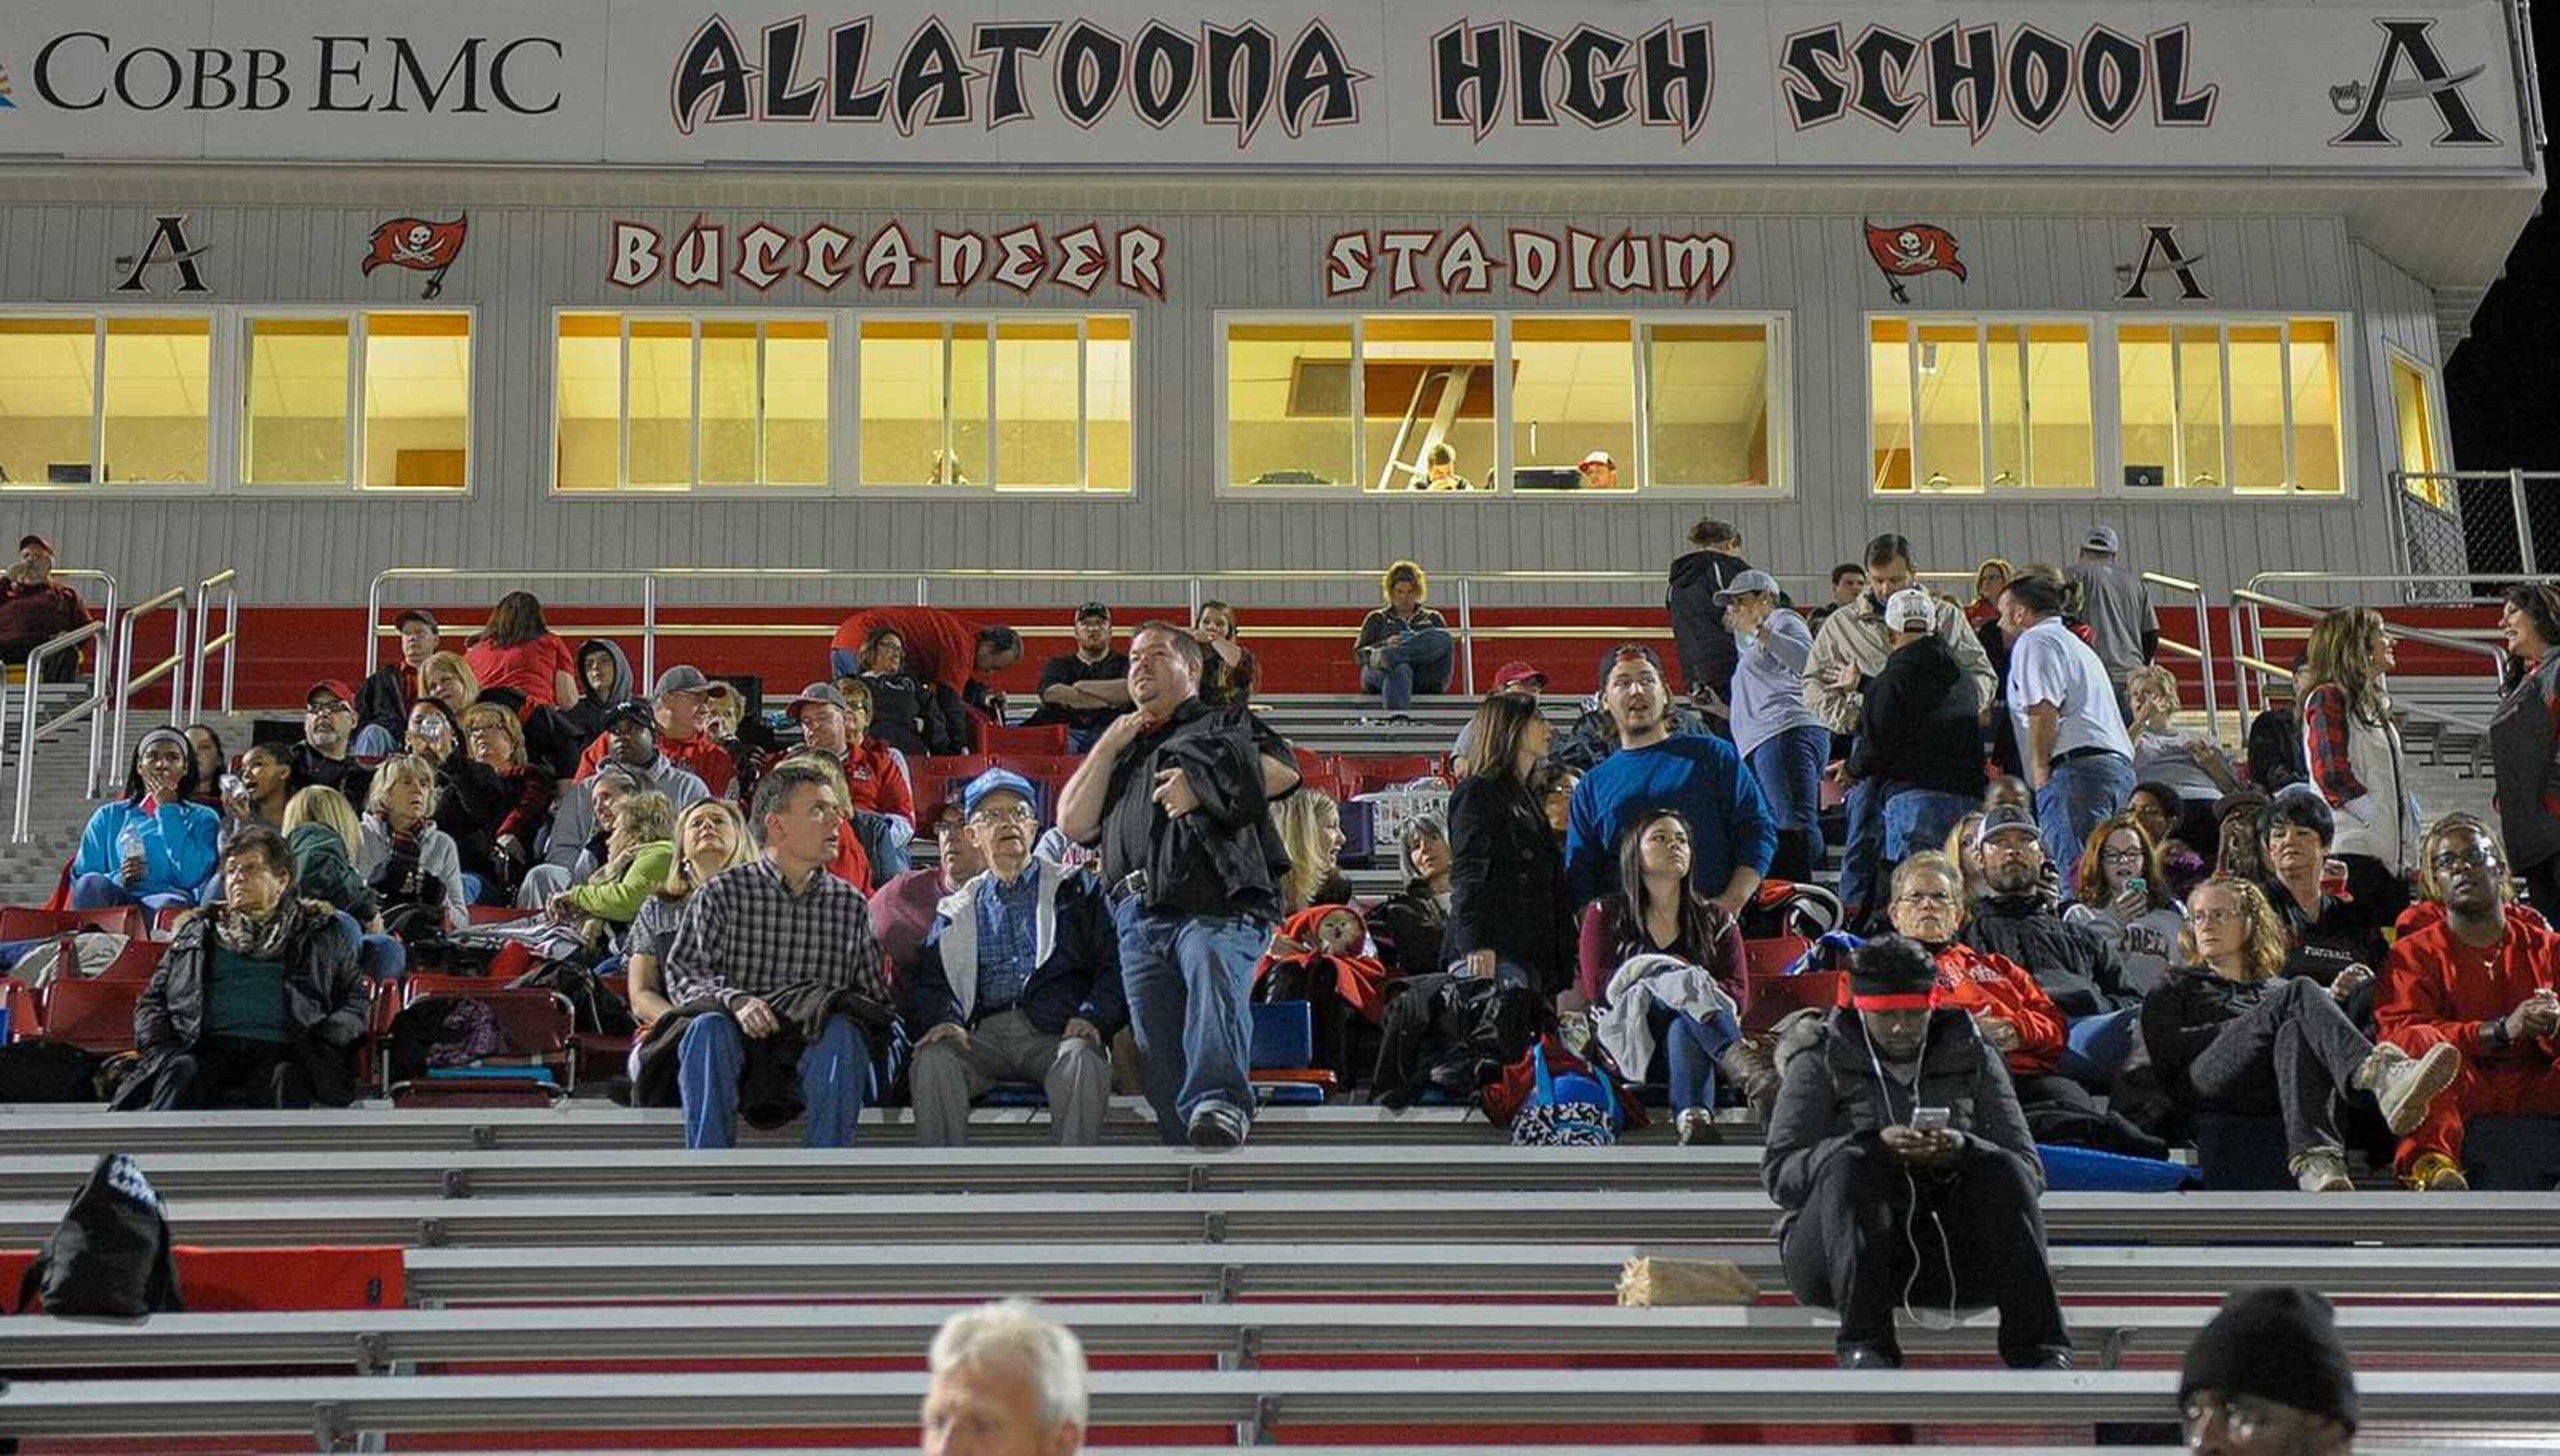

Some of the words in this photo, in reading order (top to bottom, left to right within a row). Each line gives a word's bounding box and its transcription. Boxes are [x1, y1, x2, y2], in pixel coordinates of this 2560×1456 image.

[308, 35, 563, 114] EMC
[669, 13, 1375, 149] ALLATOONA
[1430, 17, 1717, 144] HIGH
[1779, 20, 2220, 145] SCHOOL
[2327, 17, 2503, 147] A
[110, 215, 213, 293] A
[608, 213, 1167, 302] BUCCANEER
[1327, 223, 1735, 304] STADIUM
[2114, 223, 2215, 301] A
